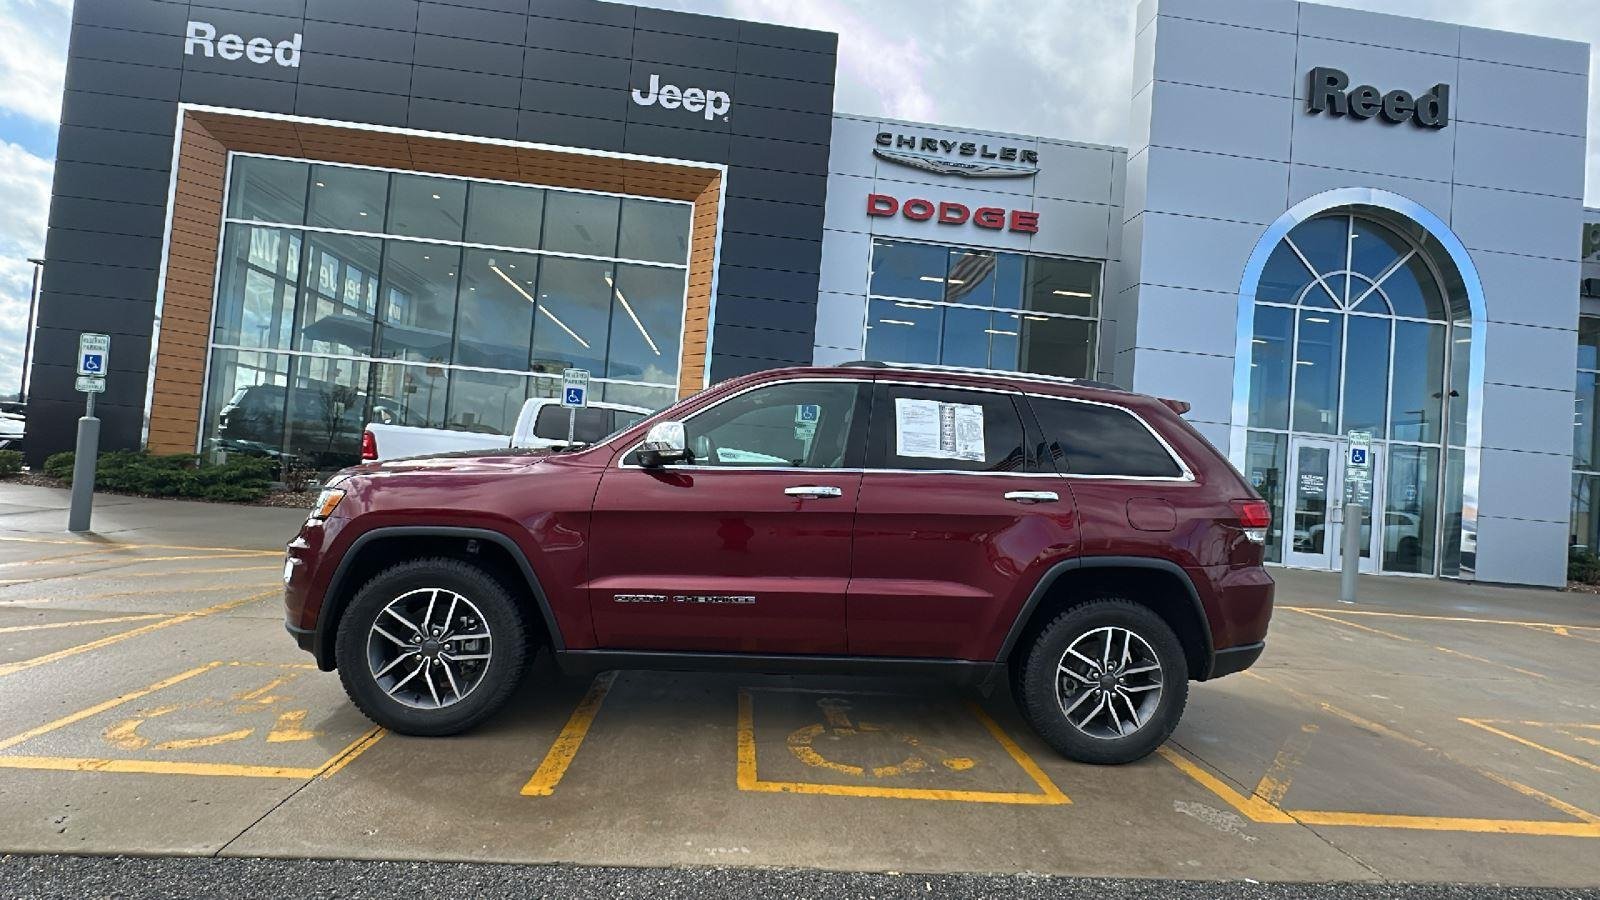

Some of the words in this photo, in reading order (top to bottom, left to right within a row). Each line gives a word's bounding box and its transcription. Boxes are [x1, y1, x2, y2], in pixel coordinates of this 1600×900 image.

[185, 21, 302, 67] Reed
[632, 74, 731, 120] Jeep
[1307, 66, 1450, 130] Reed
[875, 132, 1038, 163] CHRYSLER
[867, 194, 1040, 233] DODGE
[672, 595, 756, 604] CHEROKEE
